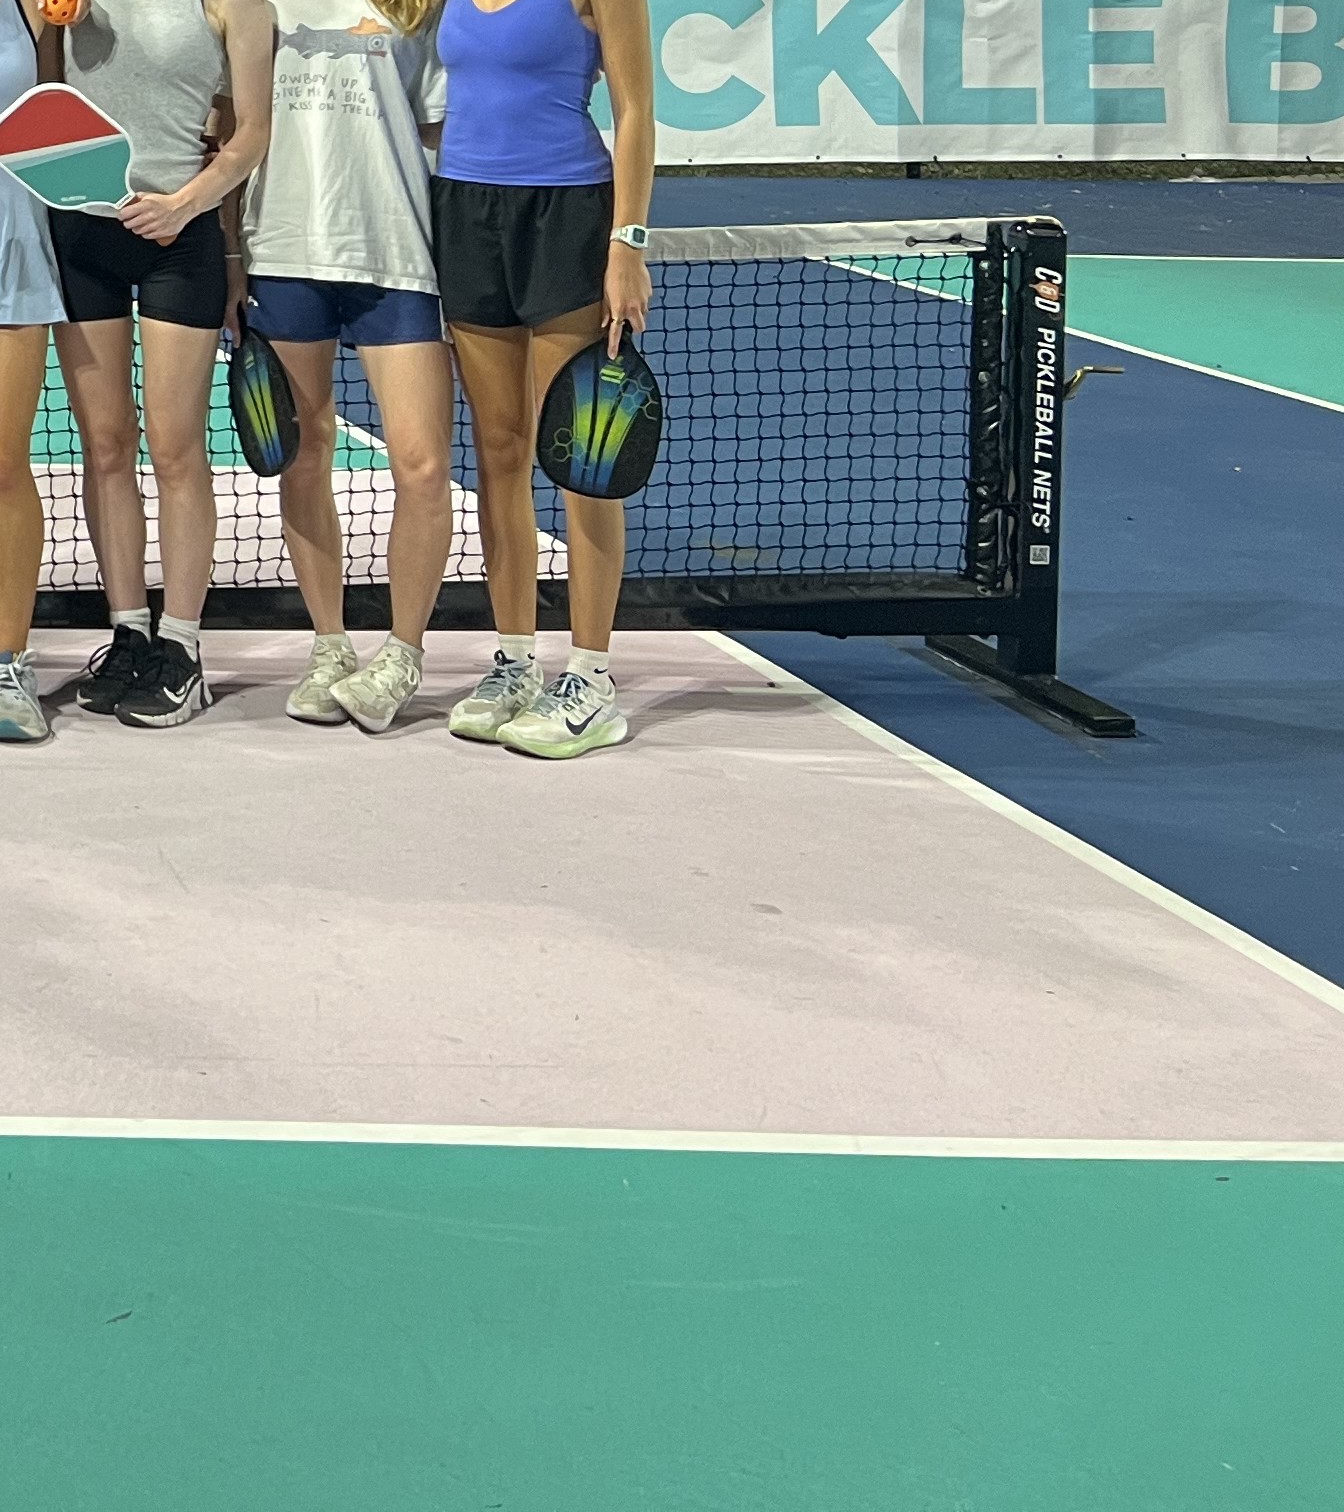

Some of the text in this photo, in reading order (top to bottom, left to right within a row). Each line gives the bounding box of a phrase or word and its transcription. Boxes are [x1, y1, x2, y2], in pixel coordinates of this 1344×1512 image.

[274, 73, 328, 86] OWBOY
[341, 78, 358, 89] UP
[327, 89, 336, 100] A
[345, 91, 366, 104] BIG
[289, 101, 312, 111] KISS
[341, 104, 362, 114] THE
[1033, 327, 1057, 464] PICKLEBALL
